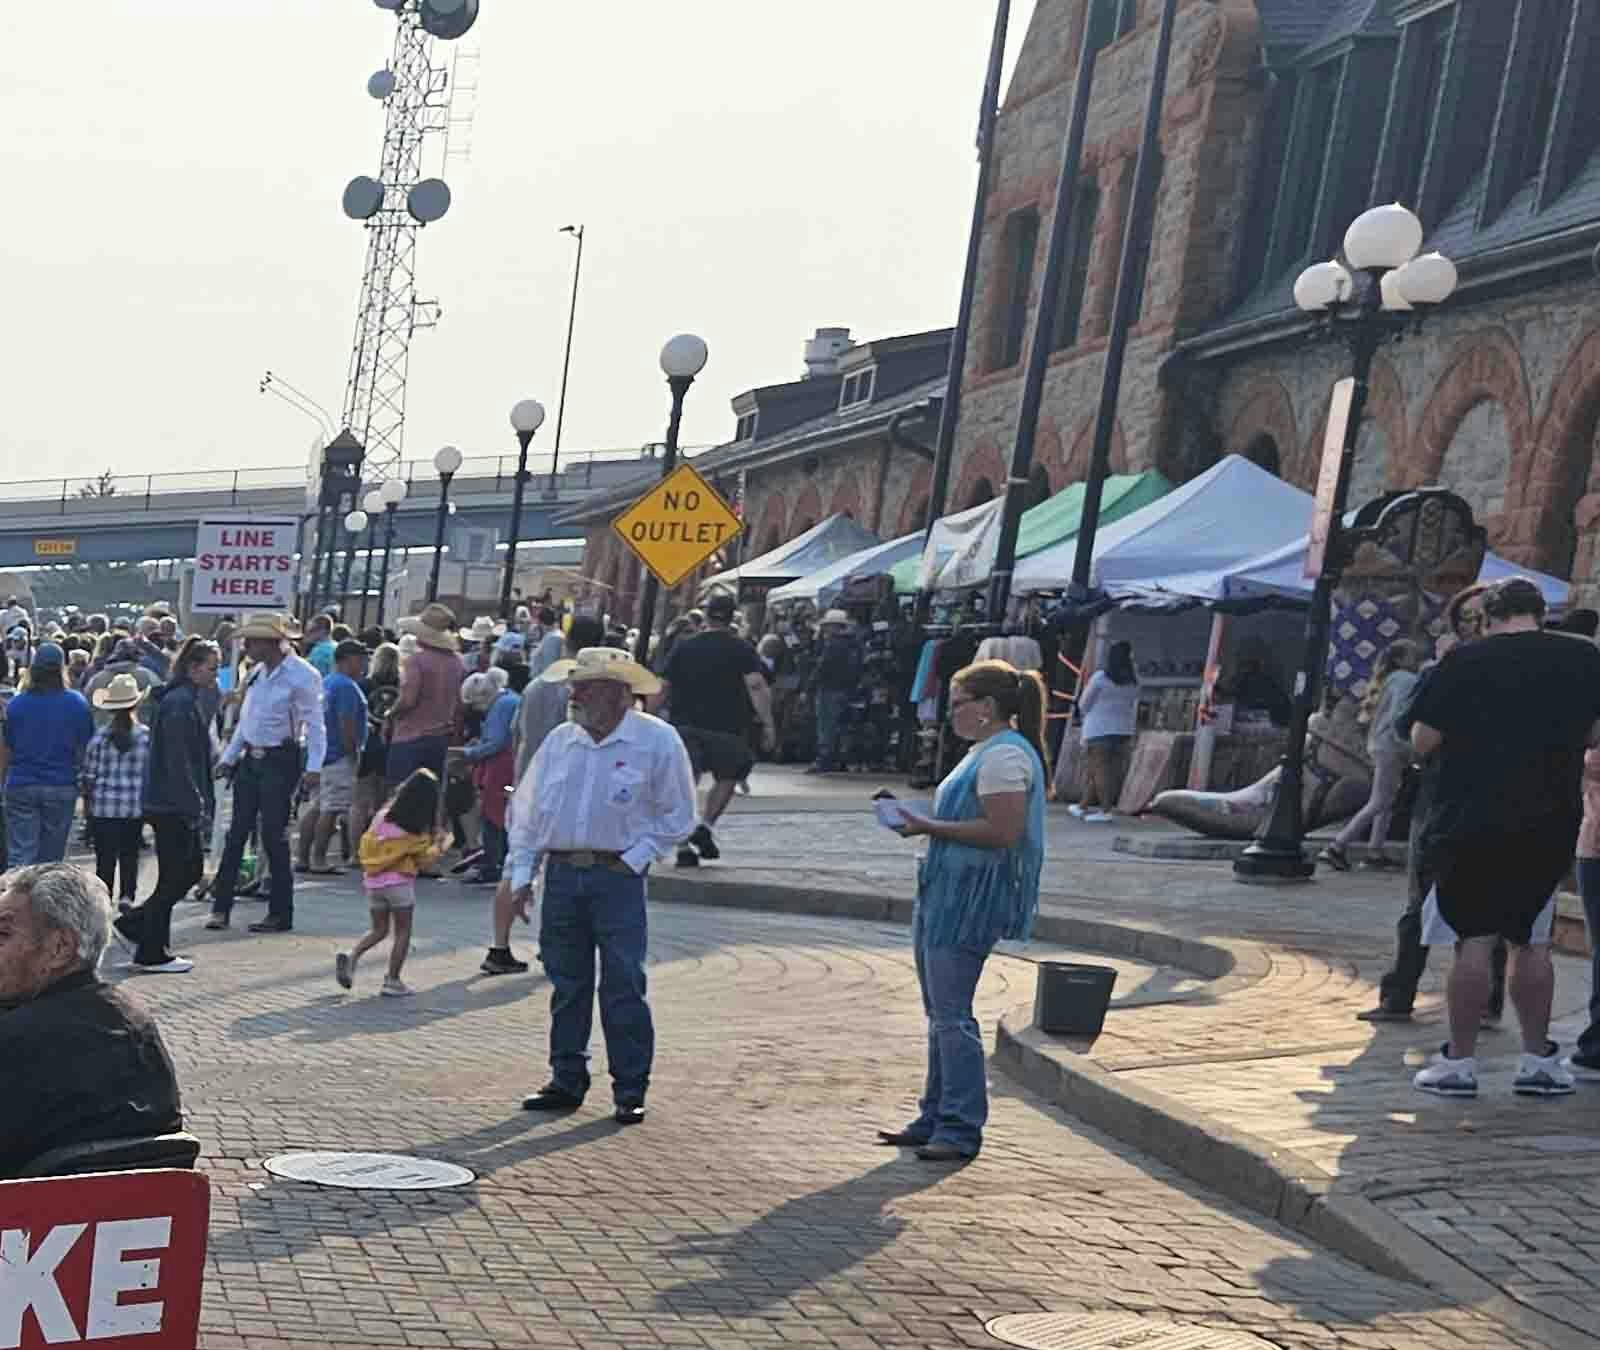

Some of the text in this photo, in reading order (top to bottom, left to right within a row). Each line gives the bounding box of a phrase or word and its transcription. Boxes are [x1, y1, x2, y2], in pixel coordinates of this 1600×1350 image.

[663, 490, 700, 511] NO
[221, 530, 274, 547] LINE
[631, 521, 727, 543] OUTLET
[200, 553, 289, 571] STARTS
[211, 579, 274, 595] HERE
